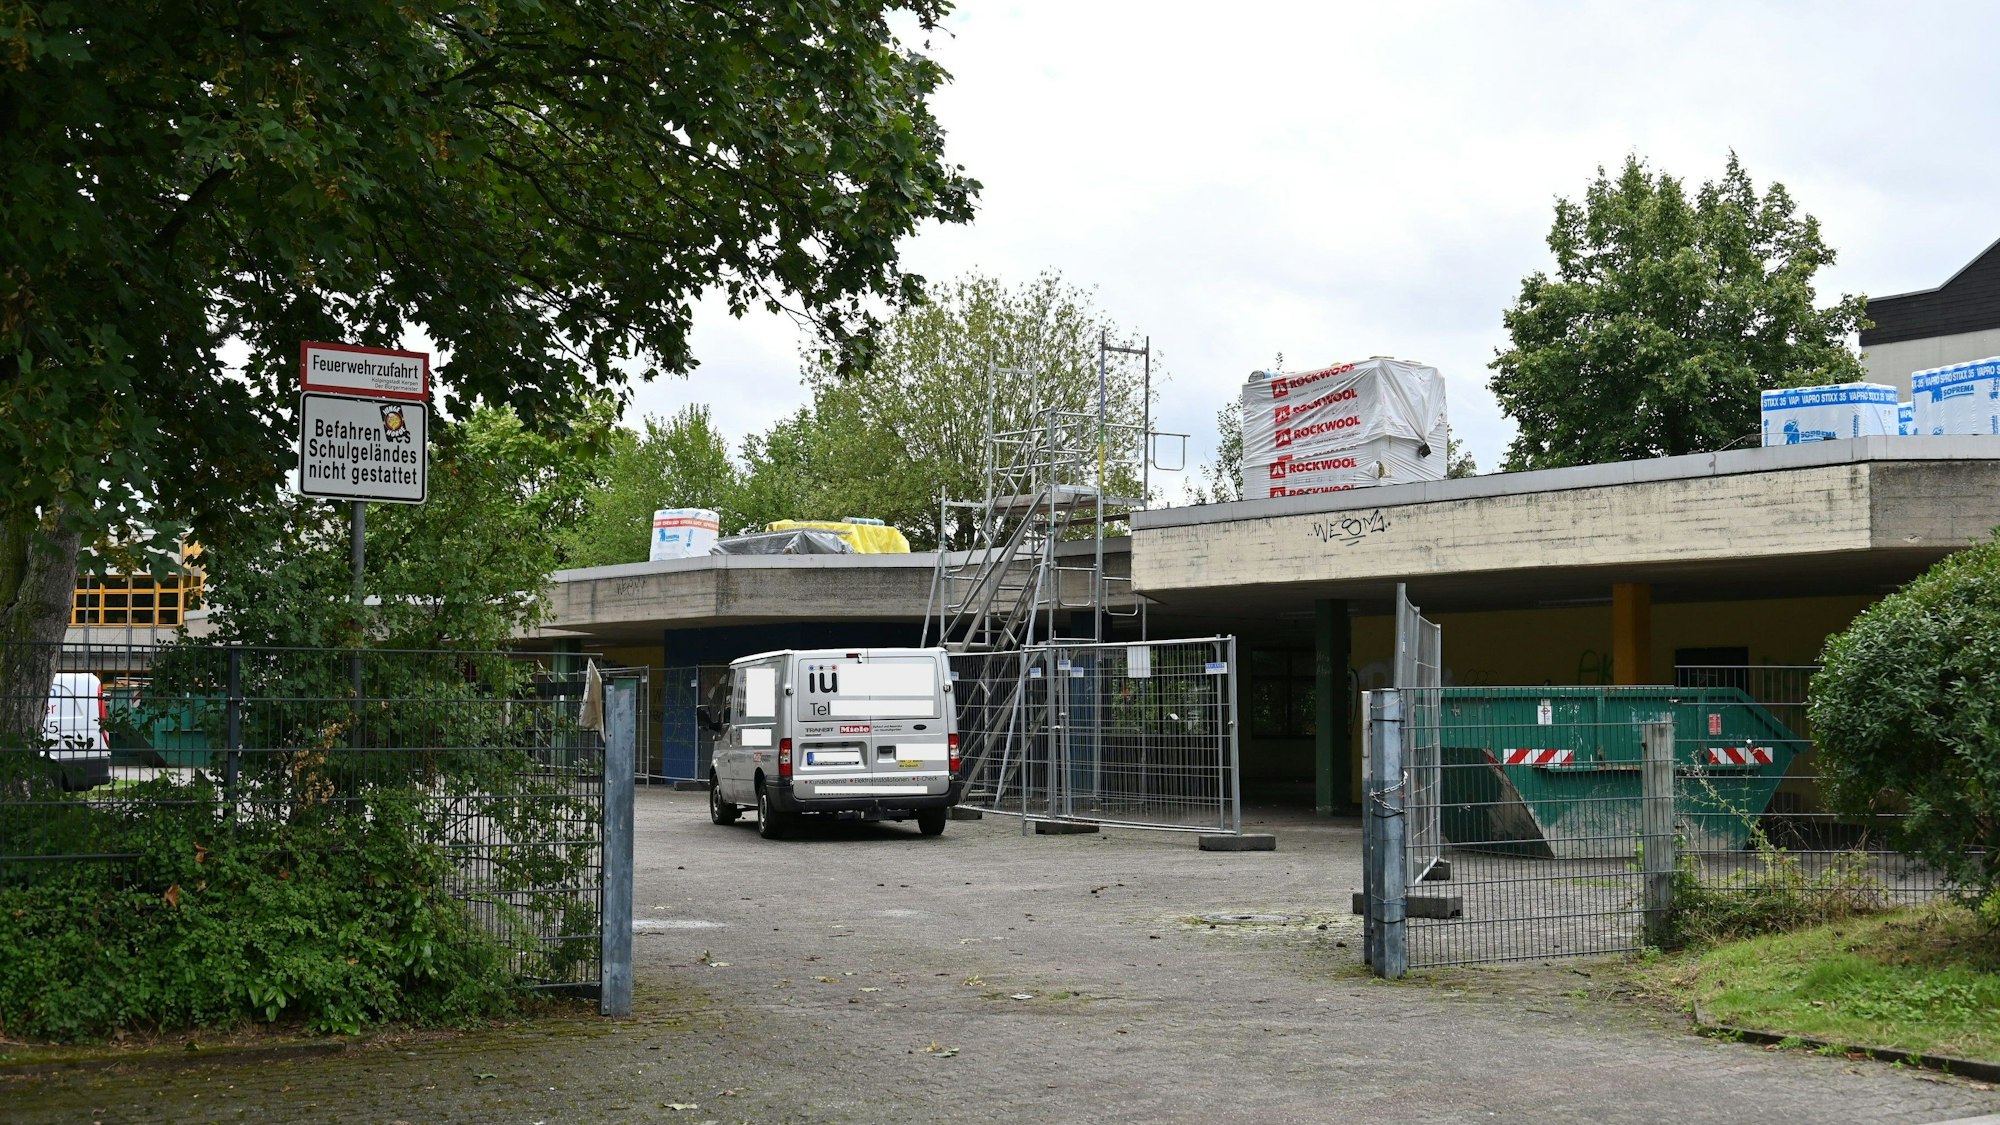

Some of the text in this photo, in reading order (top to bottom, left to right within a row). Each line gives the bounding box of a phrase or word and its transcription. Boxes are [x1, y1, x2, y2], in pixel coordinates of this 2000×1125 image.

[313, 355, 418, 379] Feuerwehrzufahrt
[1968, 369, 1975, 378] 35
[1977, 365, 1995, 377] VAPRO
[1289, 364, 1354, 388] ROCKWOOL
[384, 383, 418, 391] Bürgermeister
[1944, 385, 1975, 397] SOPREMA
[1780, 397, 1787, 407] 35
[1802, 394, 1820, 404] VAPRO
[1821, 392, 1838, 403] STIXX
[1839, 392, 1847, 402] 35
[315, 418, 381, 442] Befahren
[1294, 416, 1360, 439] ROCKWOOL
[309, 438, 417, 464] Schulgeländes
[309, 460, 417, 485] nicht gestattet
[1289, 458, 1357, 473] ROCKWOOL
[810, 701, 831, 716] Tel
[840, 725, 870, 734] Miele
